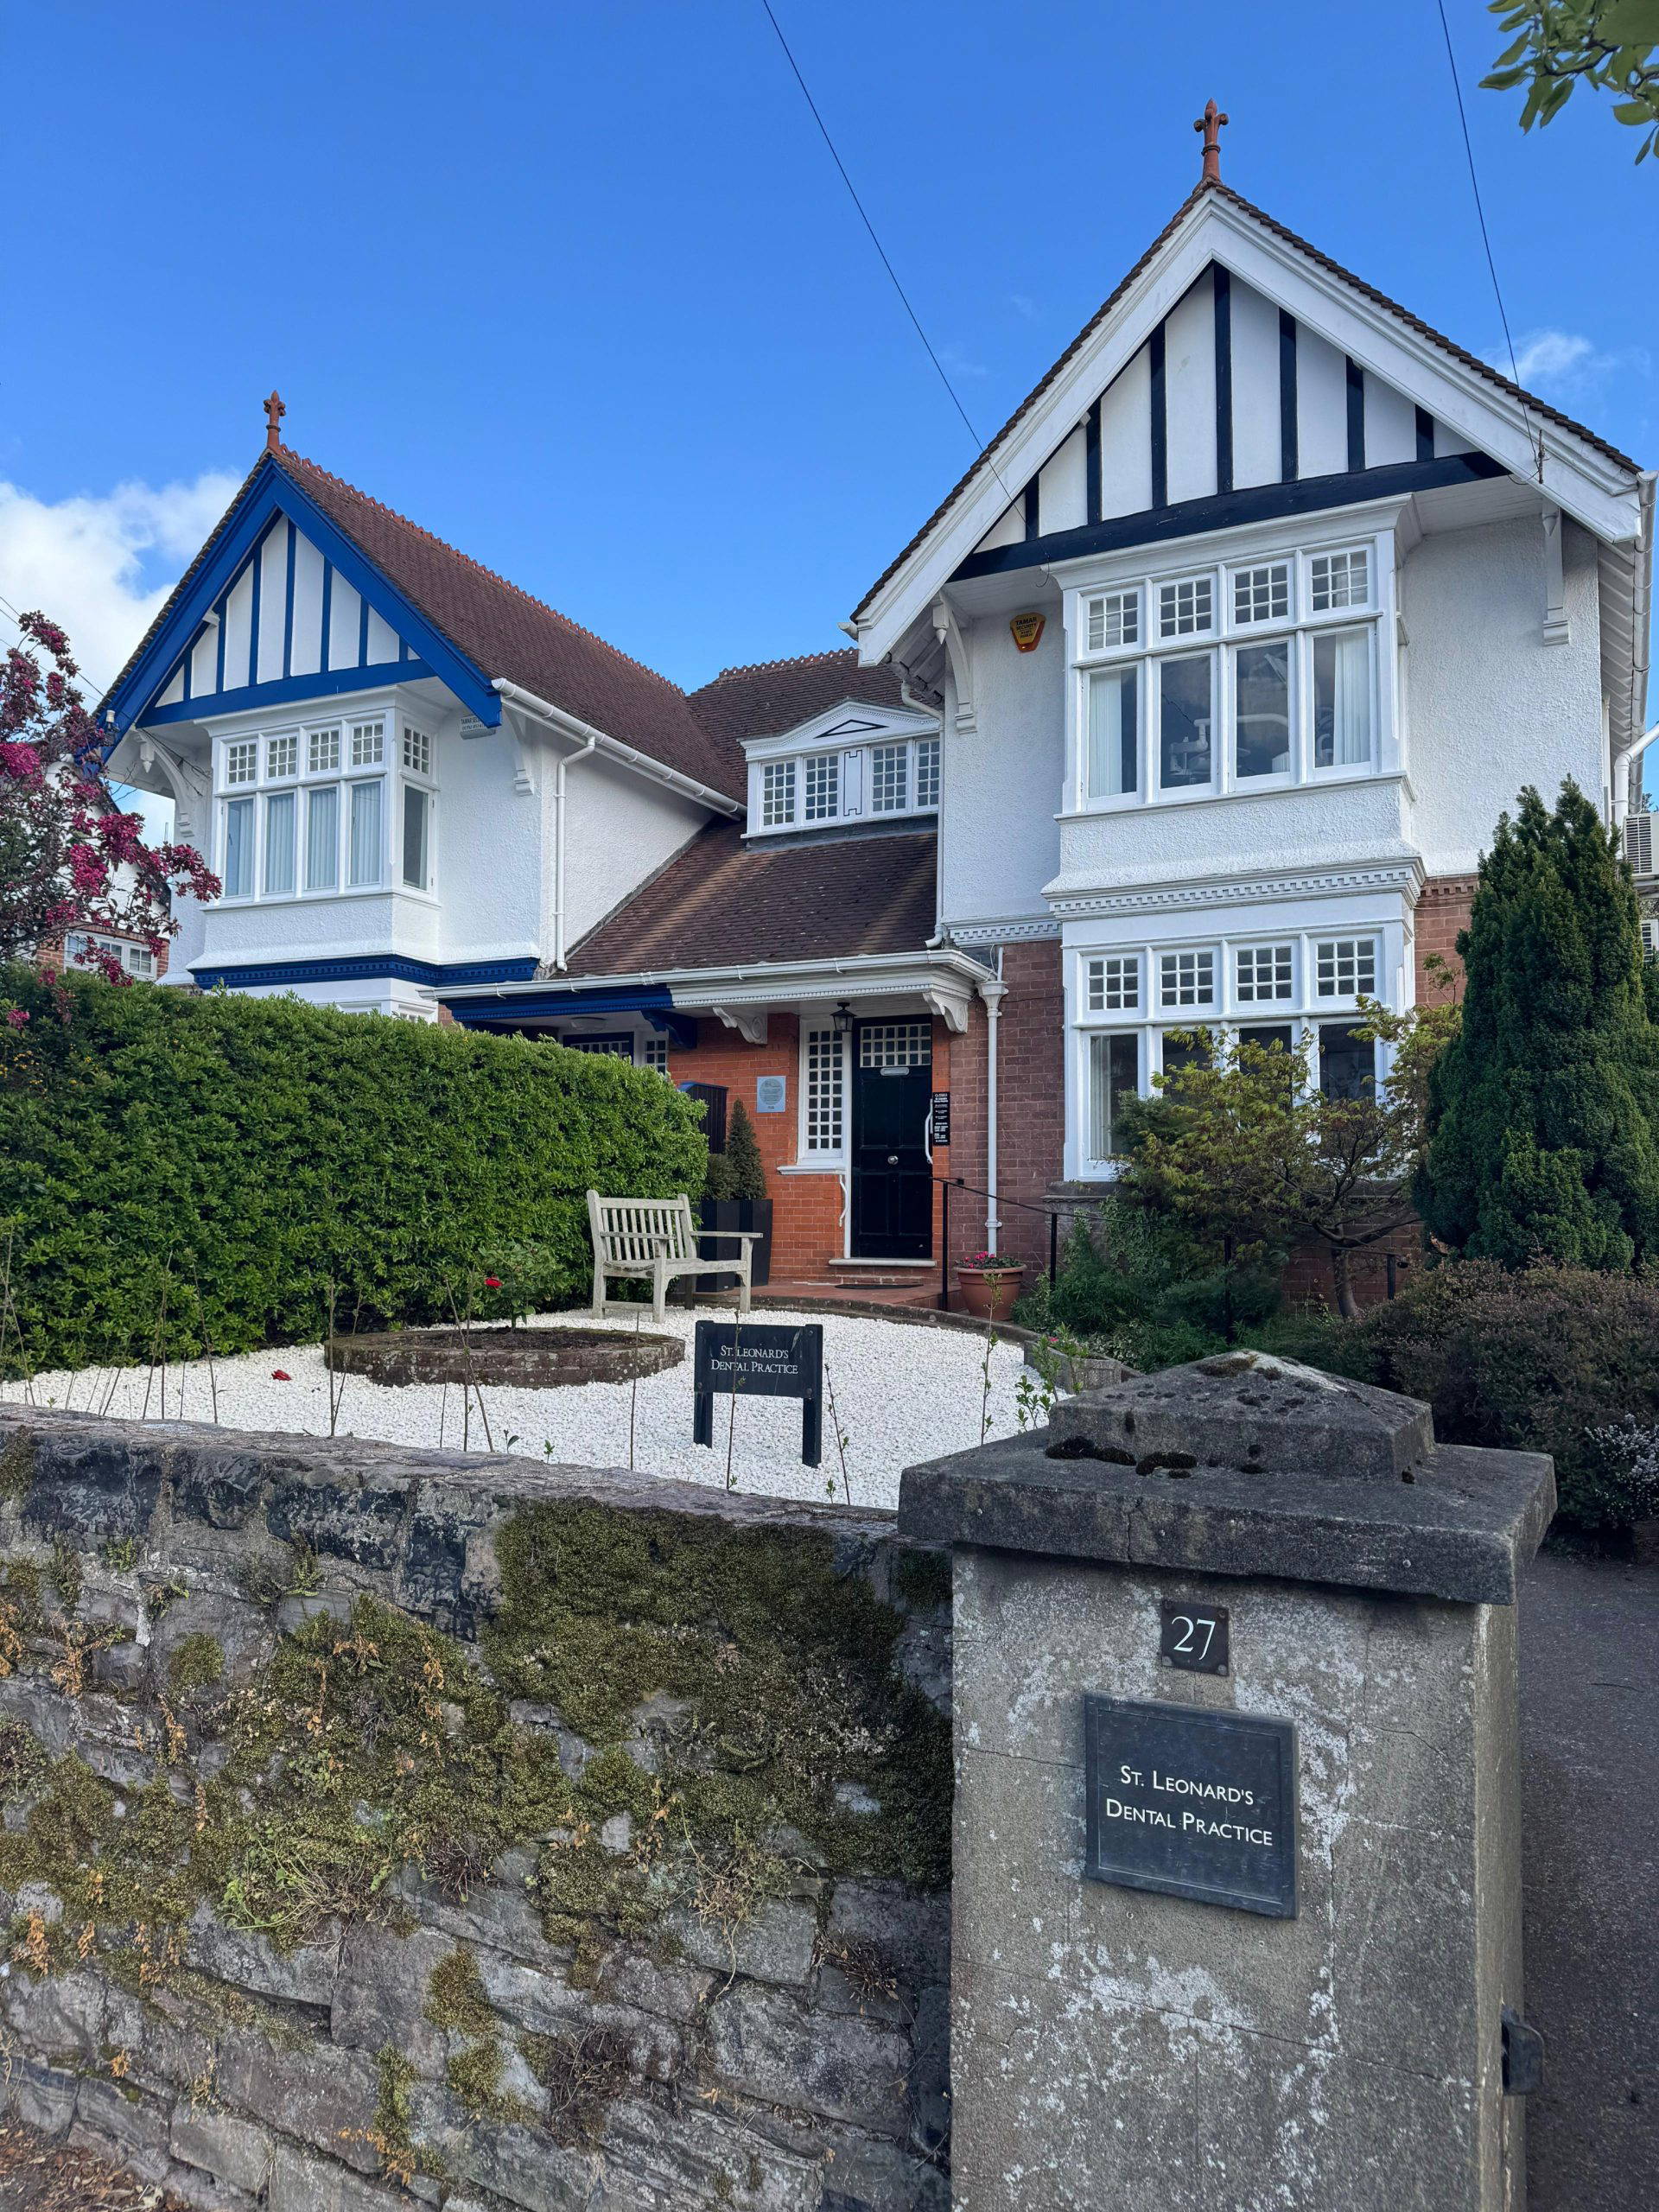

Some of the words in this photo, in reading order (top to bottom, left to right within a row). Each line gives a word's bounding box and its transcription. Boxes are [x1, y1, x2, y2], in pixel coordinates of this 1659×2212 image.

[711, 1359, 750, 1372] DENTAL
[751, 1361, 799, 1375] PRACTICE
[737, 1346, 790, 1359] LEONARD'S
[1171, 1615, 1217, 1661] 27
[1120, 1764, 1145, 1787] ST.
[1153, 1770, 1255, 1805] LEONARD'S
[1106, 1797, 1177, 1829] DENTAL
[1182, 1811, 1274, 1847] PRACTICE
